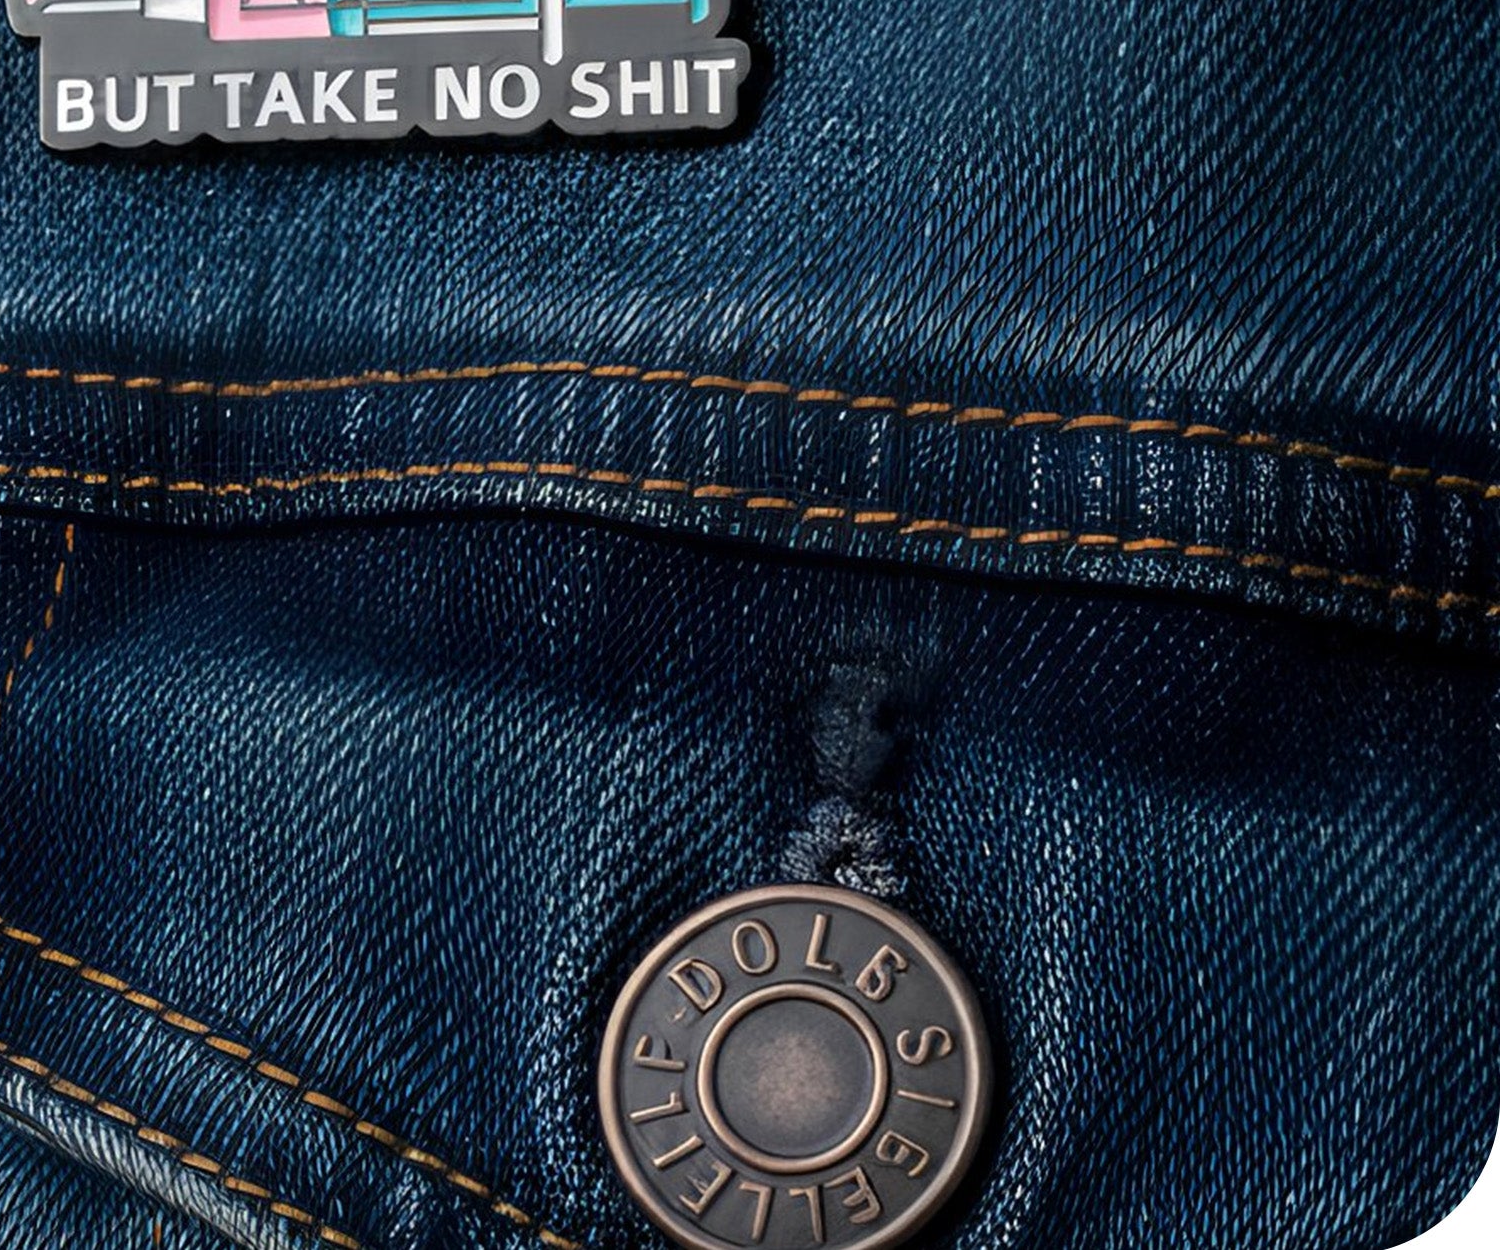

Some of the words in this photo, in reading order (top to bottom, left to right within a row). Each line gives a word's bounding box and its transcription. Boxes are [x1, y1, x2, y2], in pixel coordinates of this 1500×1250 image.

[55, 73, 195, 133] BUT
[213, 68, 398, 129] TAKE
[435, 64, 541, 121] NO
[568, 57, 737, 120] SHIT
